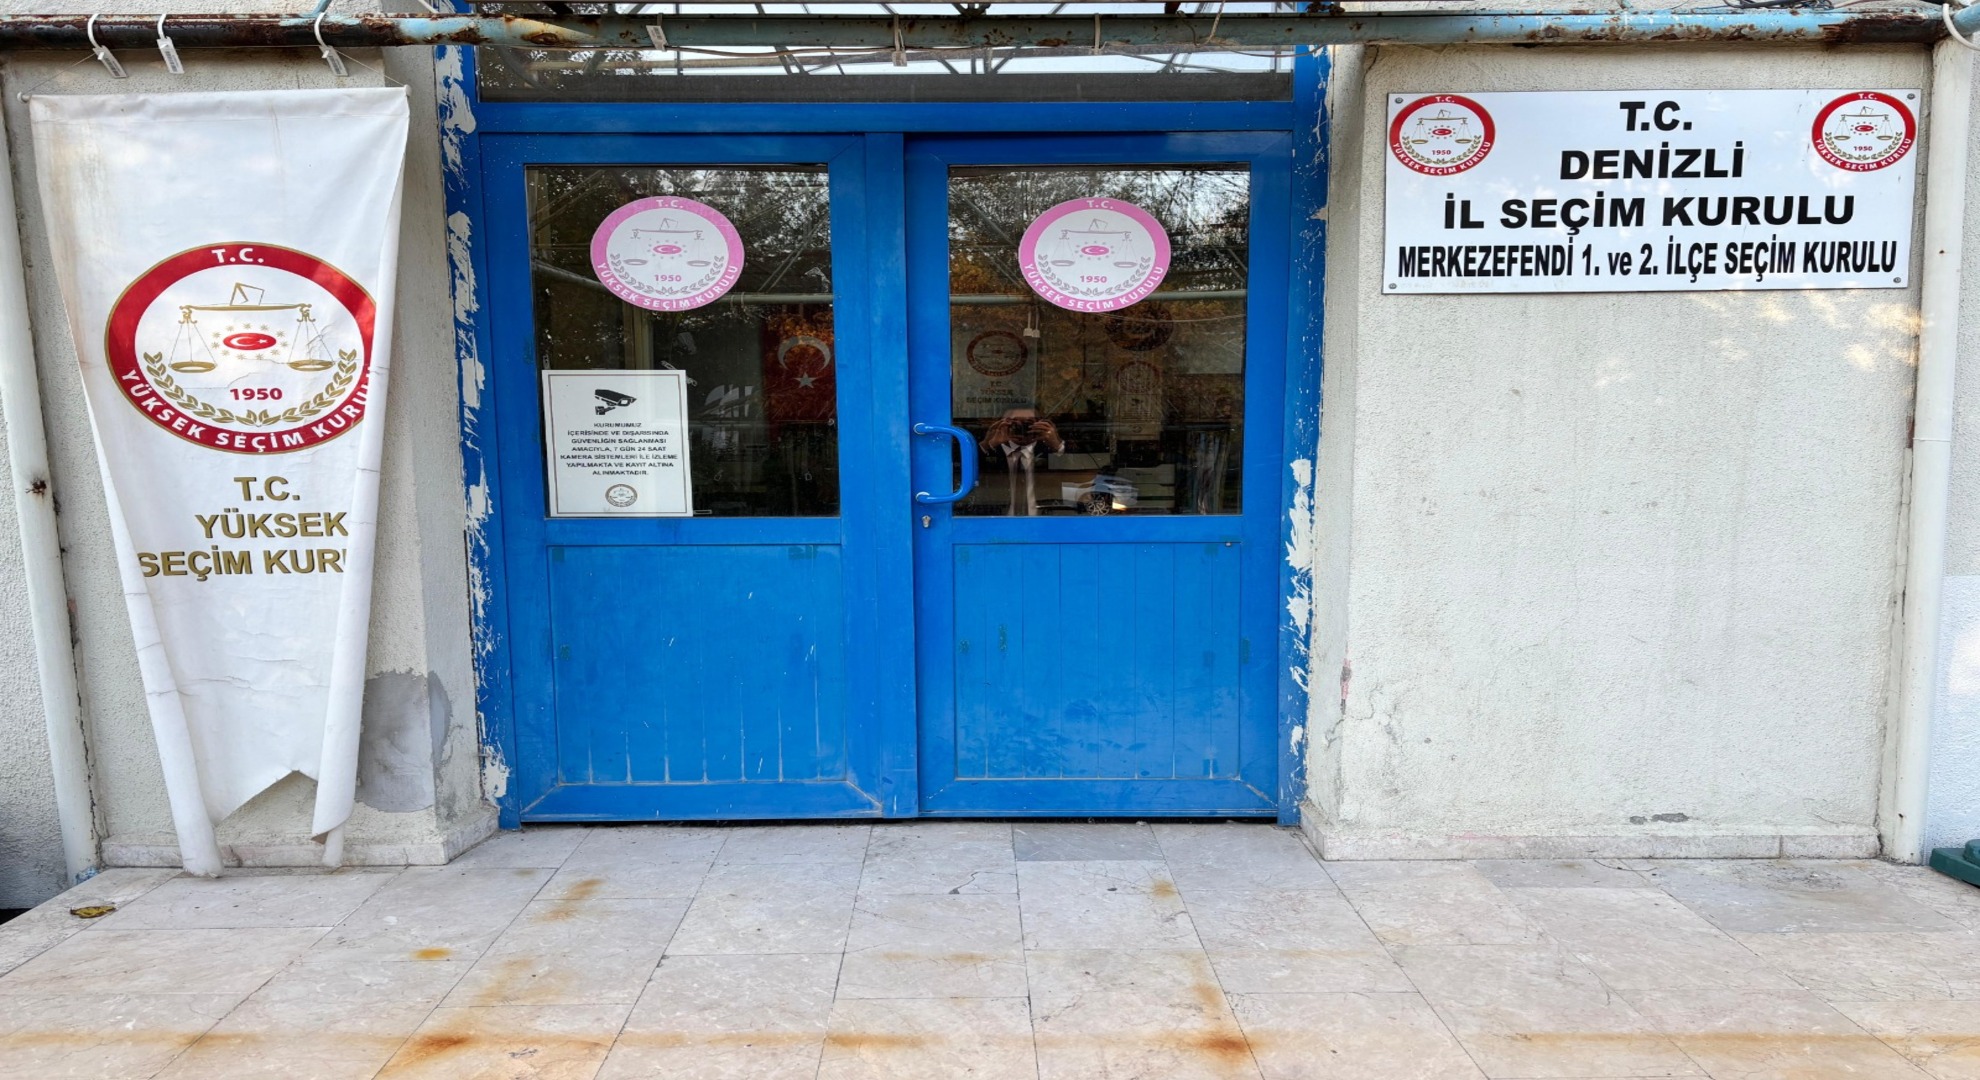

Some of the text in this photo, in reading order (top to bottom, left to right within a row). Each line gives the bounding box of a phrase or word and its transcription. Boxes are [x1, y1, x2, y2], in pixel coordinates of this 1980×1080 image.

[1620, 101, 1692, 132] T.C.
[1393, 141, 1491, 175] YÜKSEK SEÇİM KURULU
[1560, 140, 1744, 180] DENİZLİ
[1816, 138, 1912, 171] YÜKSEK SEÇİM KURULU
[656, 199, 684, 209] T.C.
[1087, 200, 1114, 209] T.C.
[1444, 191, 1855, 235] İL SEÇİM KURULU
[212, 247, 264, 265] T.C.
[1398, 234, 1896, 283] MERKEZEFENDİ 1. ve 2. İLÇE SEÇİM KURULU
[598, 262, 738, 310] YÜKSEK SEÇİM KURULU
[1024, 264, 1164, 312] YÜKSEK SEÇİM KURULU
[230, 387, 282, 400] 1950
[121, 370, 207, 439] YÜKSEK
[215, 432, 304, 452] SEÇİM
[234, 476, 300, 501] T.C.
[195, 508, 348, 538] YÜKSEK
[138, 545, 252, 581] SEÇİM
